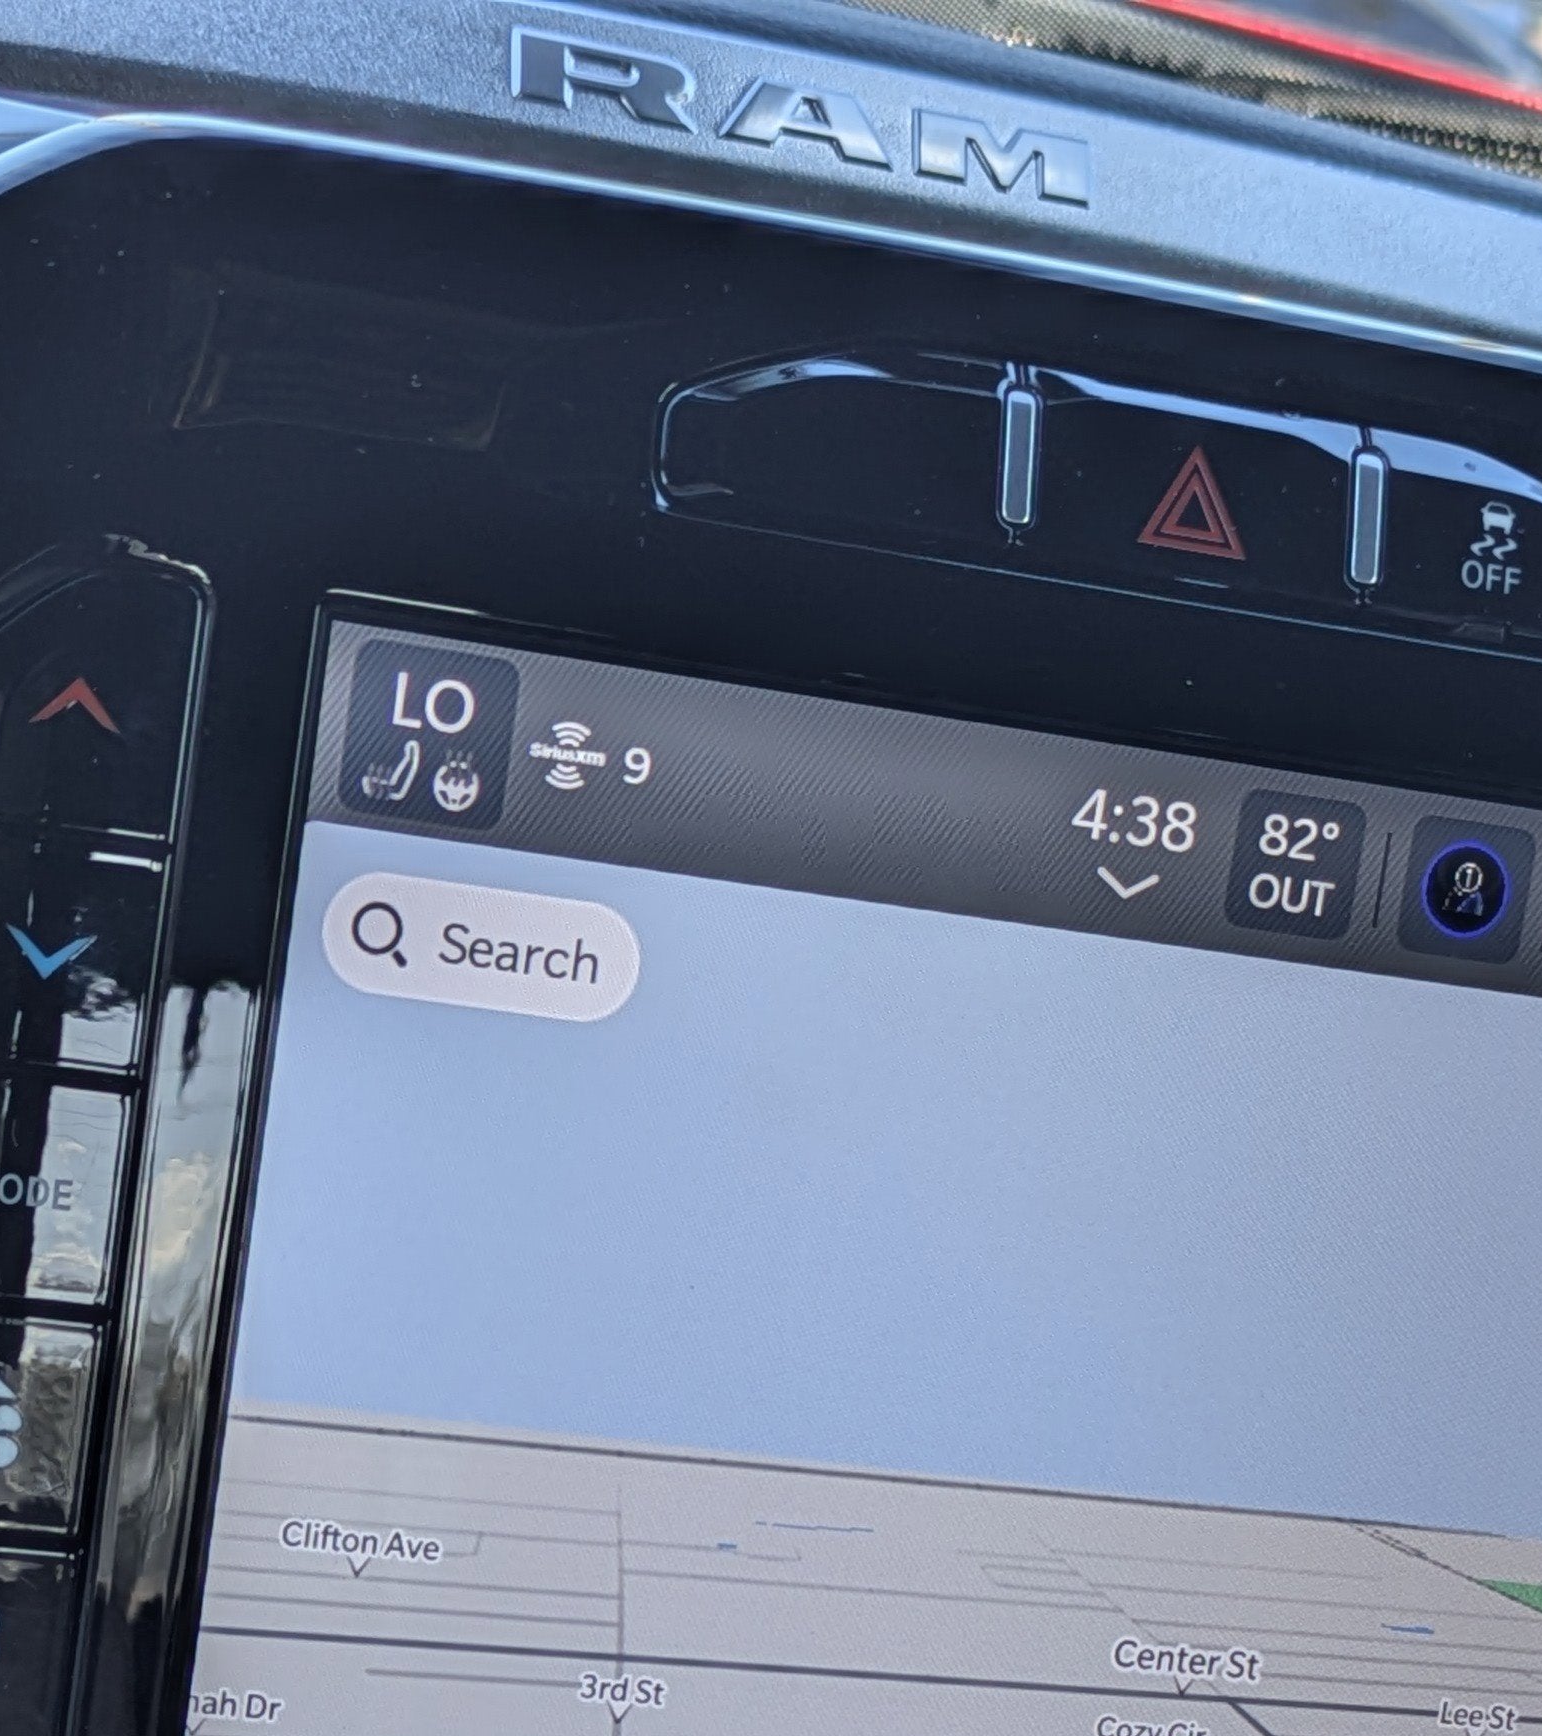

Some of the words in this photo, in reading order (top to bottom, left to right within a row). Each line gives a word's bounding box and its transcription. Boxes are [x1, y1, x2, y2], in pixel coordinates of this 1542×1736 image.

[510, 24, 1090, 210] RAM
[1460, 559, 1522, 595] OFF
[391, 670, 475, 734] LO
[622, 747, 651, 785] 9
[1072, 788, 1199, 853] 4:38
[1258, 813, 1341, 863] 82°
[1248, 872, 1336, 919] OUT
[438, 922, 600, 985] Search
[281, 1520, 378, 1556] Clifton
[383, 1531, 441, 1561] Ave
[1114, 1640, 1221, 1677] Center
[1225, 1651, 1260, 1681] St
[245, 1694, 282, 1720] Dr
[579, 1673, 629, 1702] 3rd
[635, 1679, 666, 1706] St
[1439, 1702, 1484, 1727] Lee
[1489, 1705, 1517, 1731] St
